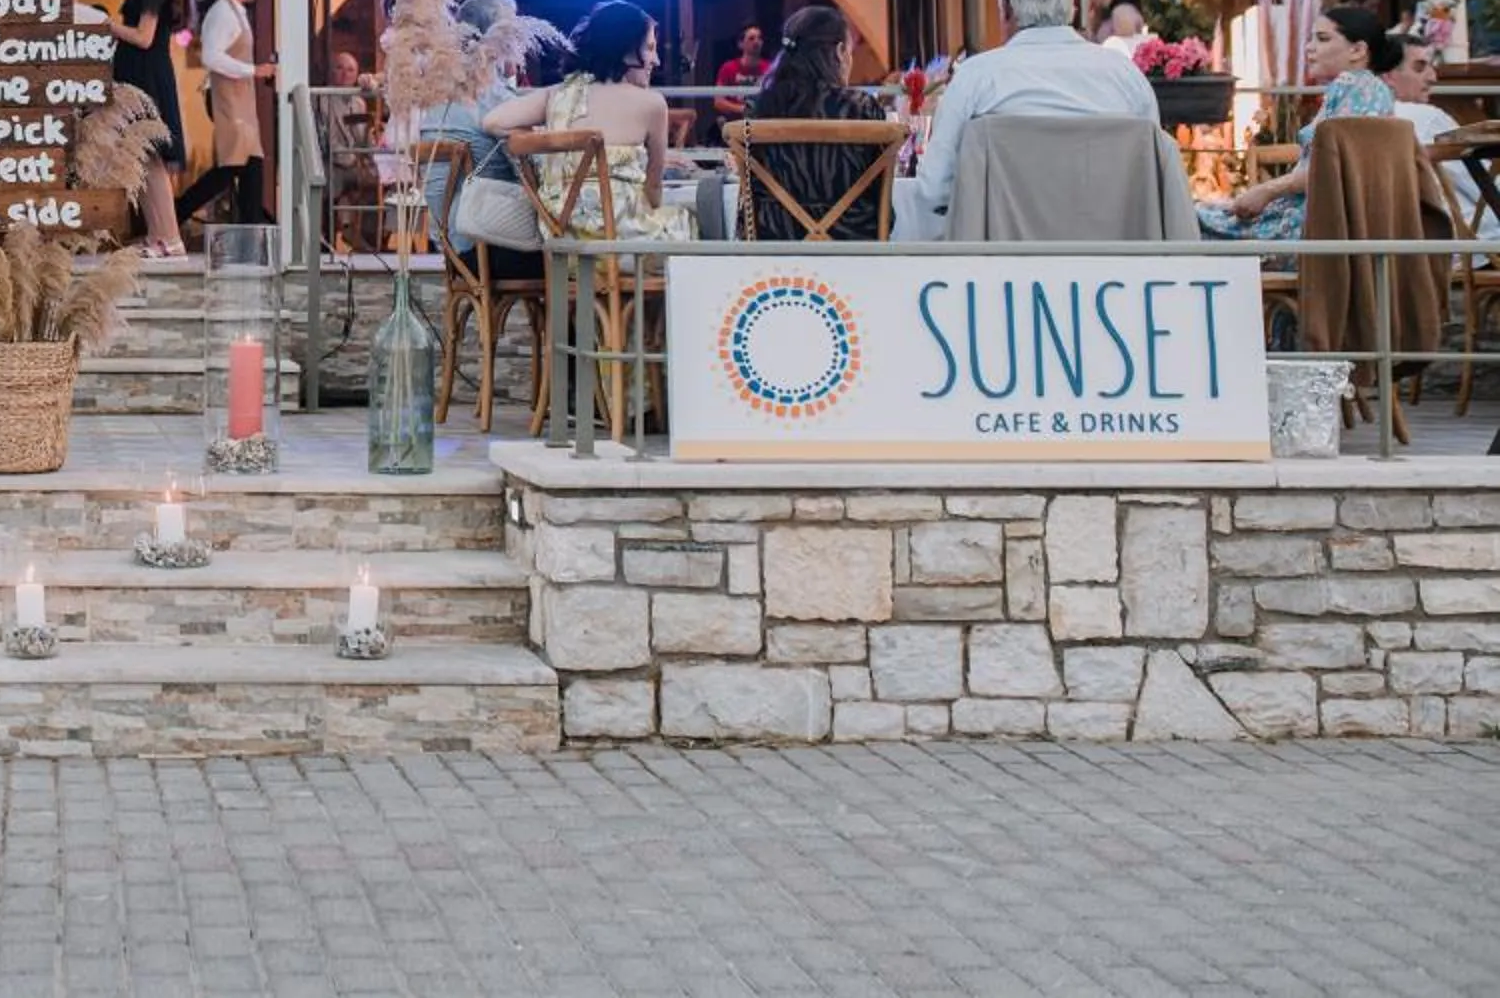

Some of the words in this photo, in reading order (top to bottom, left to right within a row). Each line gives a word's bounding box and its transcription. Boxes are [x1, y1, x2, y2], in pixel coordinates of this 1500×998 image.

[45, 78, 106, 104] one
[7, 199, 82, 228] side
[919, 281, 1228, 399] SUNSET
[976, 413, 1040, 433] CAFE
[1052, 412, 1070, 433] &
[1081, 413, 1179, 433] DRINKS
